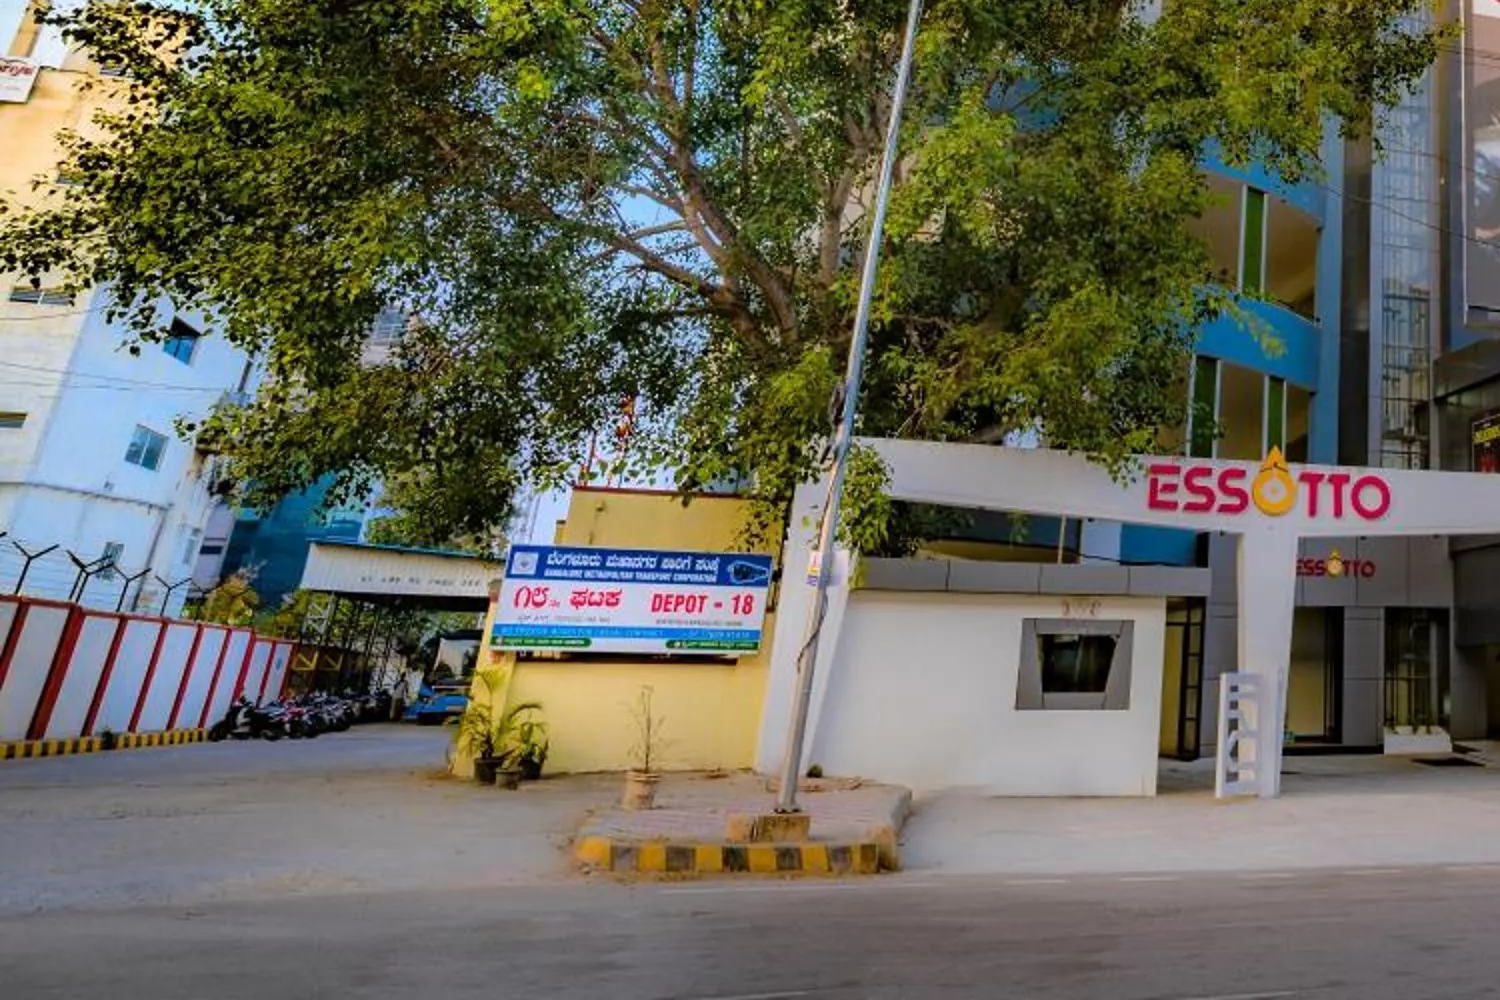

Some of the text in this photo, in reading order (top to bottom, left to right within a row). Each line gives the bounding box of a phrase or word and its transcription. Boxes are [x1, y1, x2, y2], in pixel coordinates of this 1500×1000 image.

[1148, 445, 1391, 520] ESSOTTO
[1296, 549, 1376, 579] ESSOTTO
[651, 593, 708, 614] DEPOT
[731, 594, 755, 615] 18
